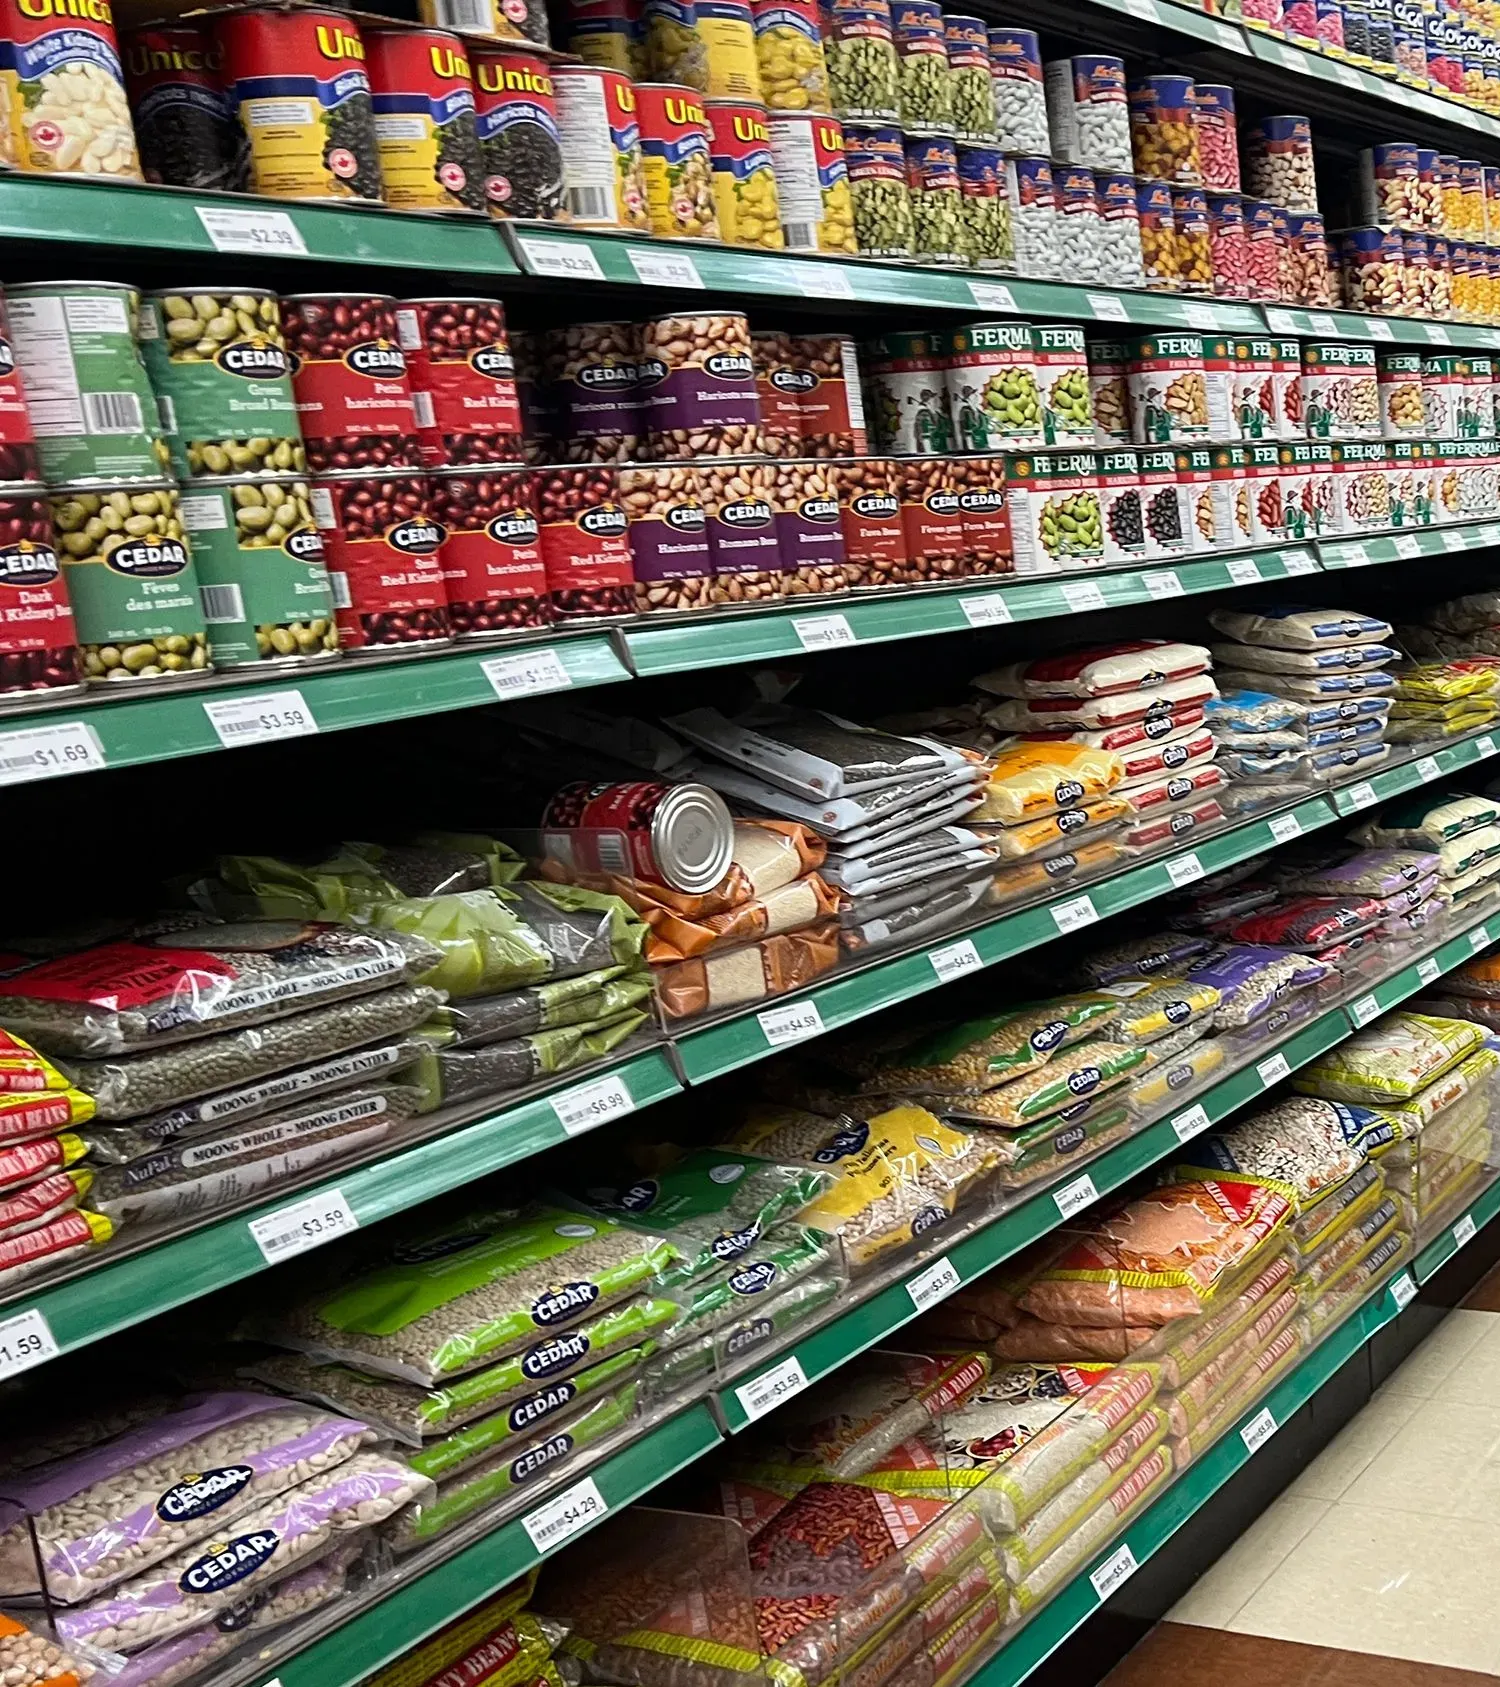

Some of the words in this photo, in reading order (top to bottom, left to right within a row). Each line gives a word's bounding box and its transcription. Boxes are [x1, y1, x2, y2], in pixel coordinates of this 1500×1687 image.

[250, 226, 293, 246] $2.39
[115, 546, 186, 569] CEDAR
[19, 591, 53, 605] Dark
[259, 711, 305, 730] $3.59
[34, 743, 89, 768] $1.69
[212, 993, 255, 1013] MOONG
[211, 1091, 257, 1115] MOONG
[259, 1076, 300, 1098] WHOLE
[309, 1063, 351, 1084] MOONG
[353, 1051, 391, 1072] ENTIER
[1069, 1068, 1102, 1091] CEDAR
[592, 1092, 624, 1117] $6.99
[192, 1138, 240, 1163] MOONG
[241, 1126, 285, 1149] WHOLE
[294, 1112, 337, 1135] MOONG
[339, 1100, 378, 1121] ENTIER
[302, 1208, 344, 1238] $3.59
[932, 1270, 953, 1292] $3.59
[535, 1284, 595, 1323] CEDAR
[727, 1321, 773, 1353] CEDAR
[524, 1335, 586, 1375] CEDAR
[774, 1371, 801, 1397] $3.59
[949, 1361, 984, 1396] BARLEY
[514, 1387, 573, 1428] CEDAR
[513, 1438, 571, 1479] CEDAR
[563, 1495, 597, 1526] $4.29
[186, 1535, 277, 1589] CEDAR
[464, 1627, 516, 1677] BEANS
